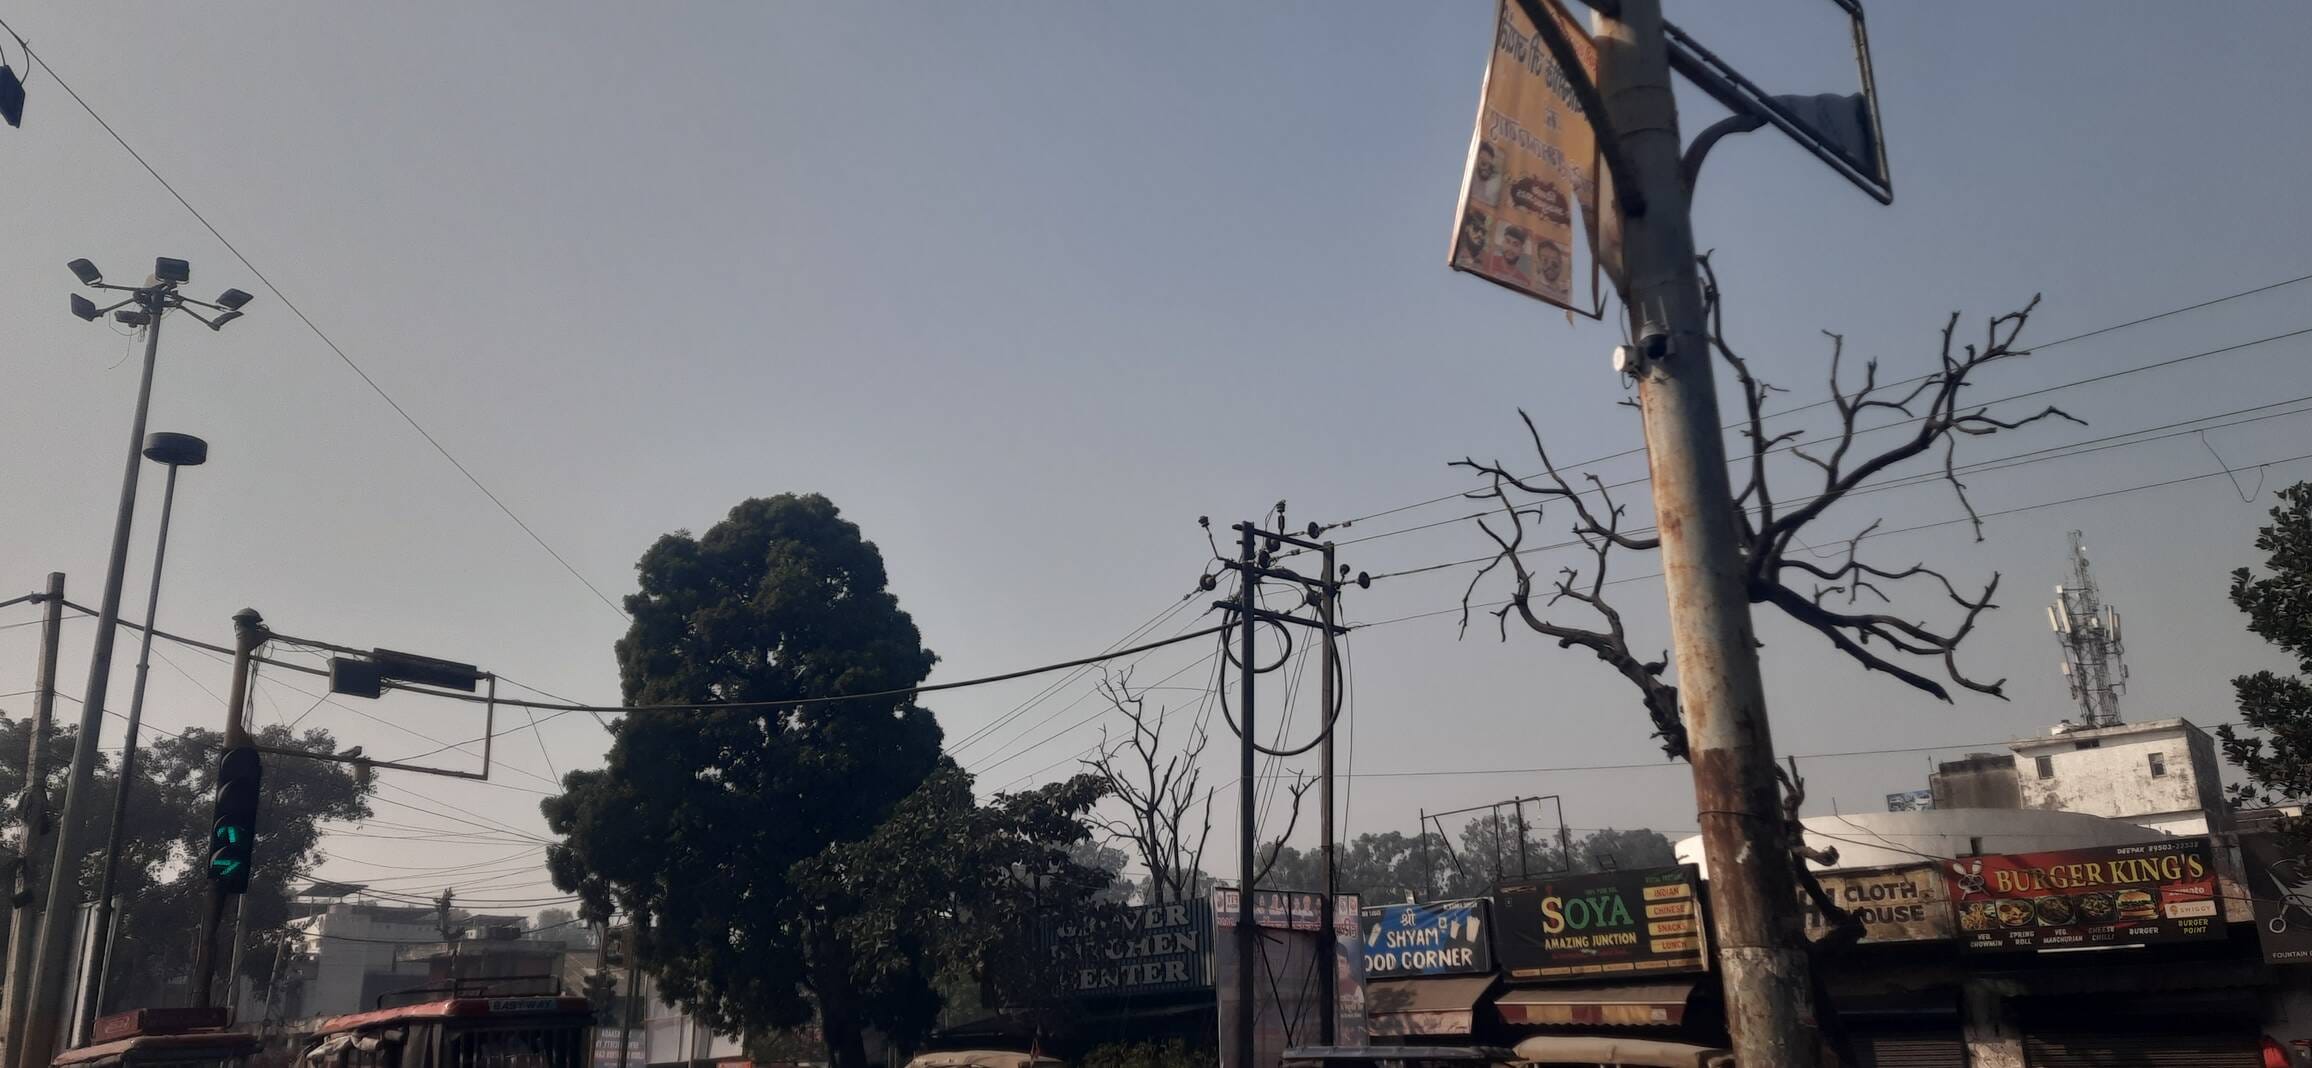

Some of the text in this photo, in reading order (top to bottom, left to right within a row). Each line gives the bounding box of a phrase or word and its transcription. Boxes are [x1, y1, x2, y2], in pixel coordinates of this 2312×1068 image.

[1995, 853, 2204, 893] BURGER KING'S
[1654, 887, 1680, 897] INDIAN
[1844, 881, 1917, 902] CLOTH
[1400, 908, 1417, 927] श्री
[1540, 894, 1635, 934] SOYA
[1653, 905, 1685, 916] CHINESE
[1852, 905, 1925, 925] OUSE
[2179, 905, 2211, 913] SWIGGY
[2129, 927, 2159, 936] BURGER
[2178, 918, 2209, 927] BURGER
[1386, 928, 1439, 948] SHYAM
[1544, 931, 1638, 951] AMAZING JUNCTION
[1662, 940, 1687, 950] LUNCH
[1364, 947, 1473, 972] OOD CORNER
[2272, 951, 2308, 959] FOUNTAIN
[1060, 960, 1190, 989] ENTER
